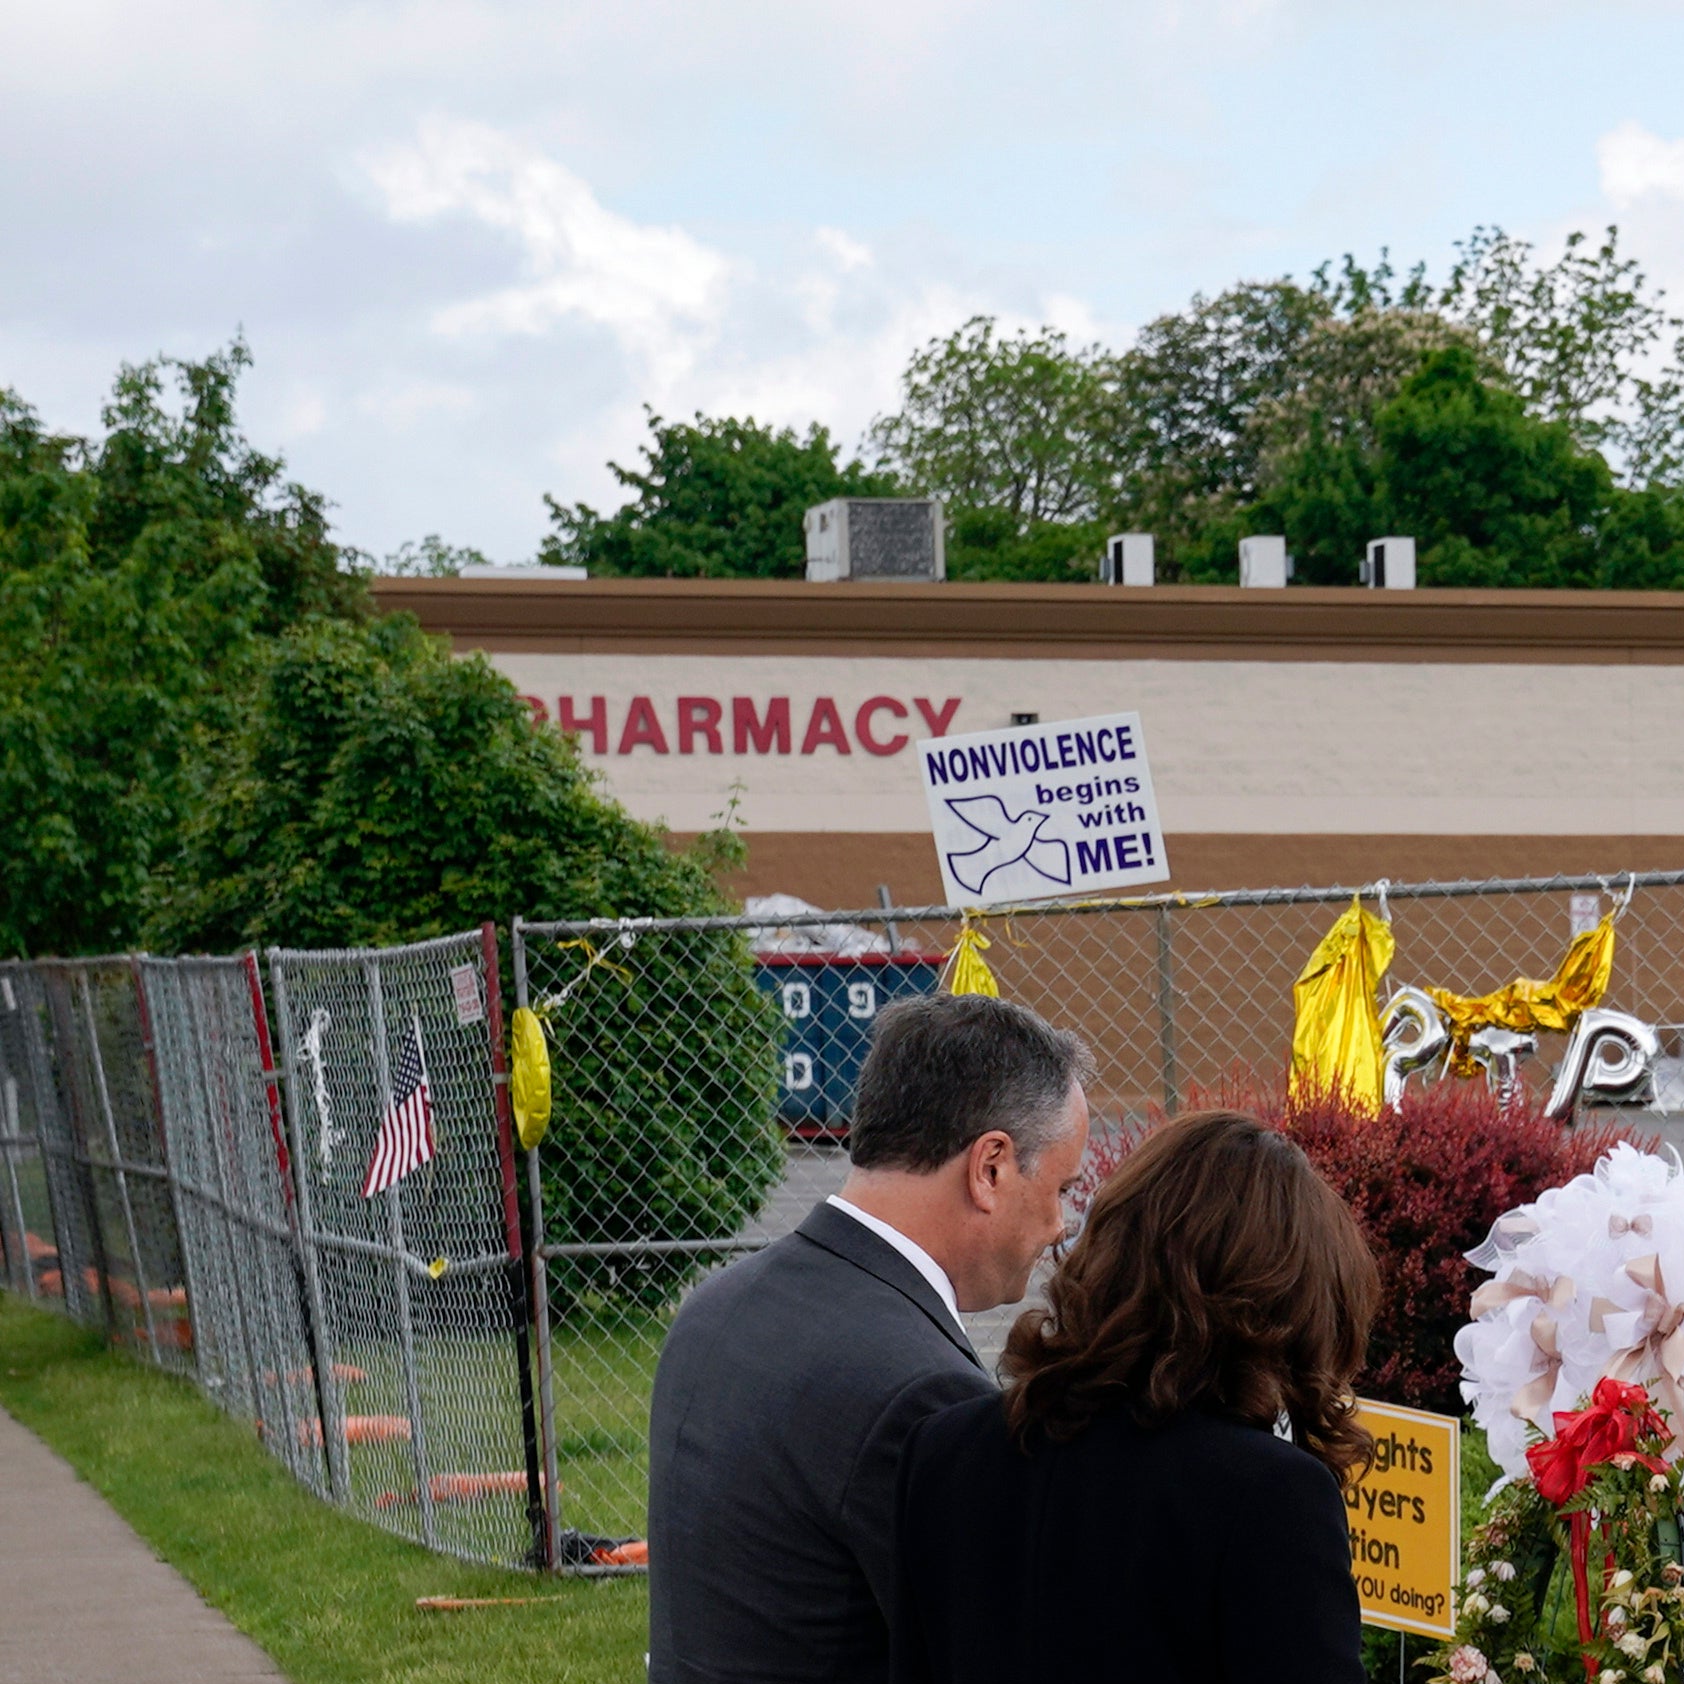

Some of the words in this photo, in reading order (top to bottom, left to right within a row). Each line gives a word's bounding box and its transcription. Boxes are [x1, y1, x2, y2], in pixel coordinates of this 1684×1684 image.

[926, 726, 1136, 786] NONVIOLENCE
[1035, 776, 1140, 805] begins
[1077, 802, 1145, 828] with
[1076, 832, 1154, 875] ME!
[1373, 1432, 1433, 1474] ghts
[1345, 1484, 1425, 1524] ayers
[1350, 1527, 1399, 1569] tion
[1390, 1583, 1445, 1617] doing?
